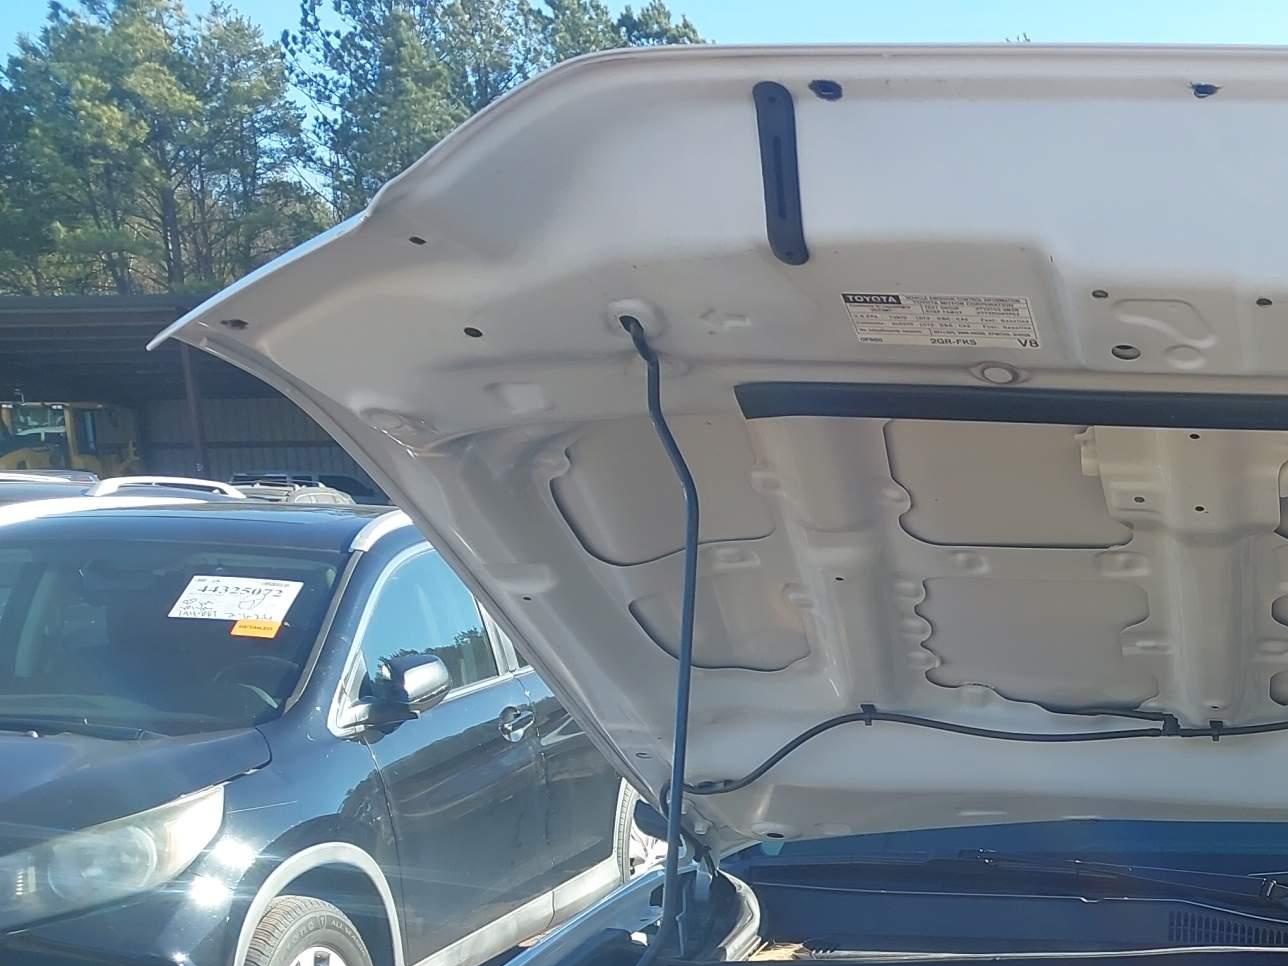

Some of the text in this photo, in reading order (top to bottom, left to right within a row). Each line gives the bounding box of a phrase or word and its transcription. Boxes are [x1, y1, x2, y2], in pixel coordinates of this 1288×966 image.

[846, 295, 898, 304] TOYOTA
[930, 338, 977, 346] 2GR-FKS
[197, 585, 283, 598] 44325072
